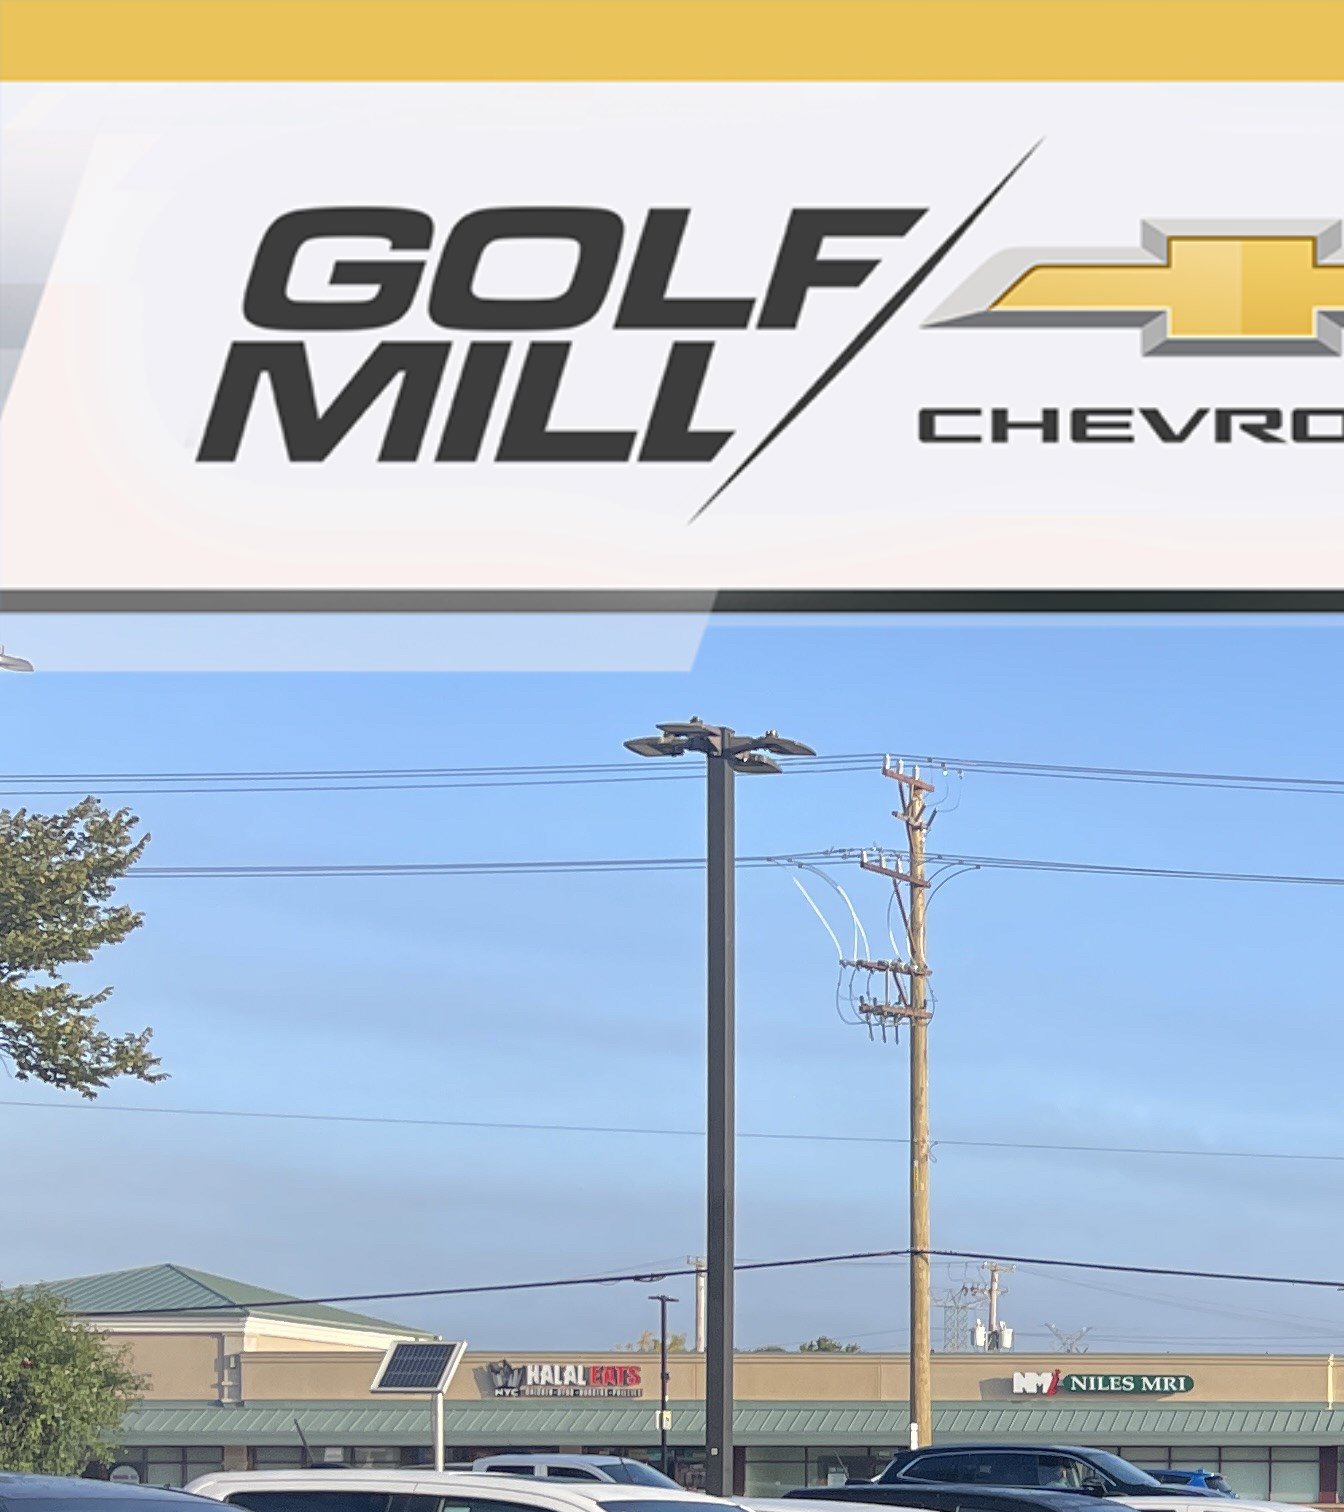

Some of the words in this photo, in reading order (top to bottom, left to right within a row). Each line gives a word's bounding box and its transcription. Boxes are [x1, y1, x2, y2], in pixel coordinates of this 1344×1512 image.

[526, 1364, 587, 1386] HALAL
[590, 1365, 642, 1387] EATS
[1070, 1376, 1135, 1391] NILES
[1141, 1376, 1187, 1391] MRI
